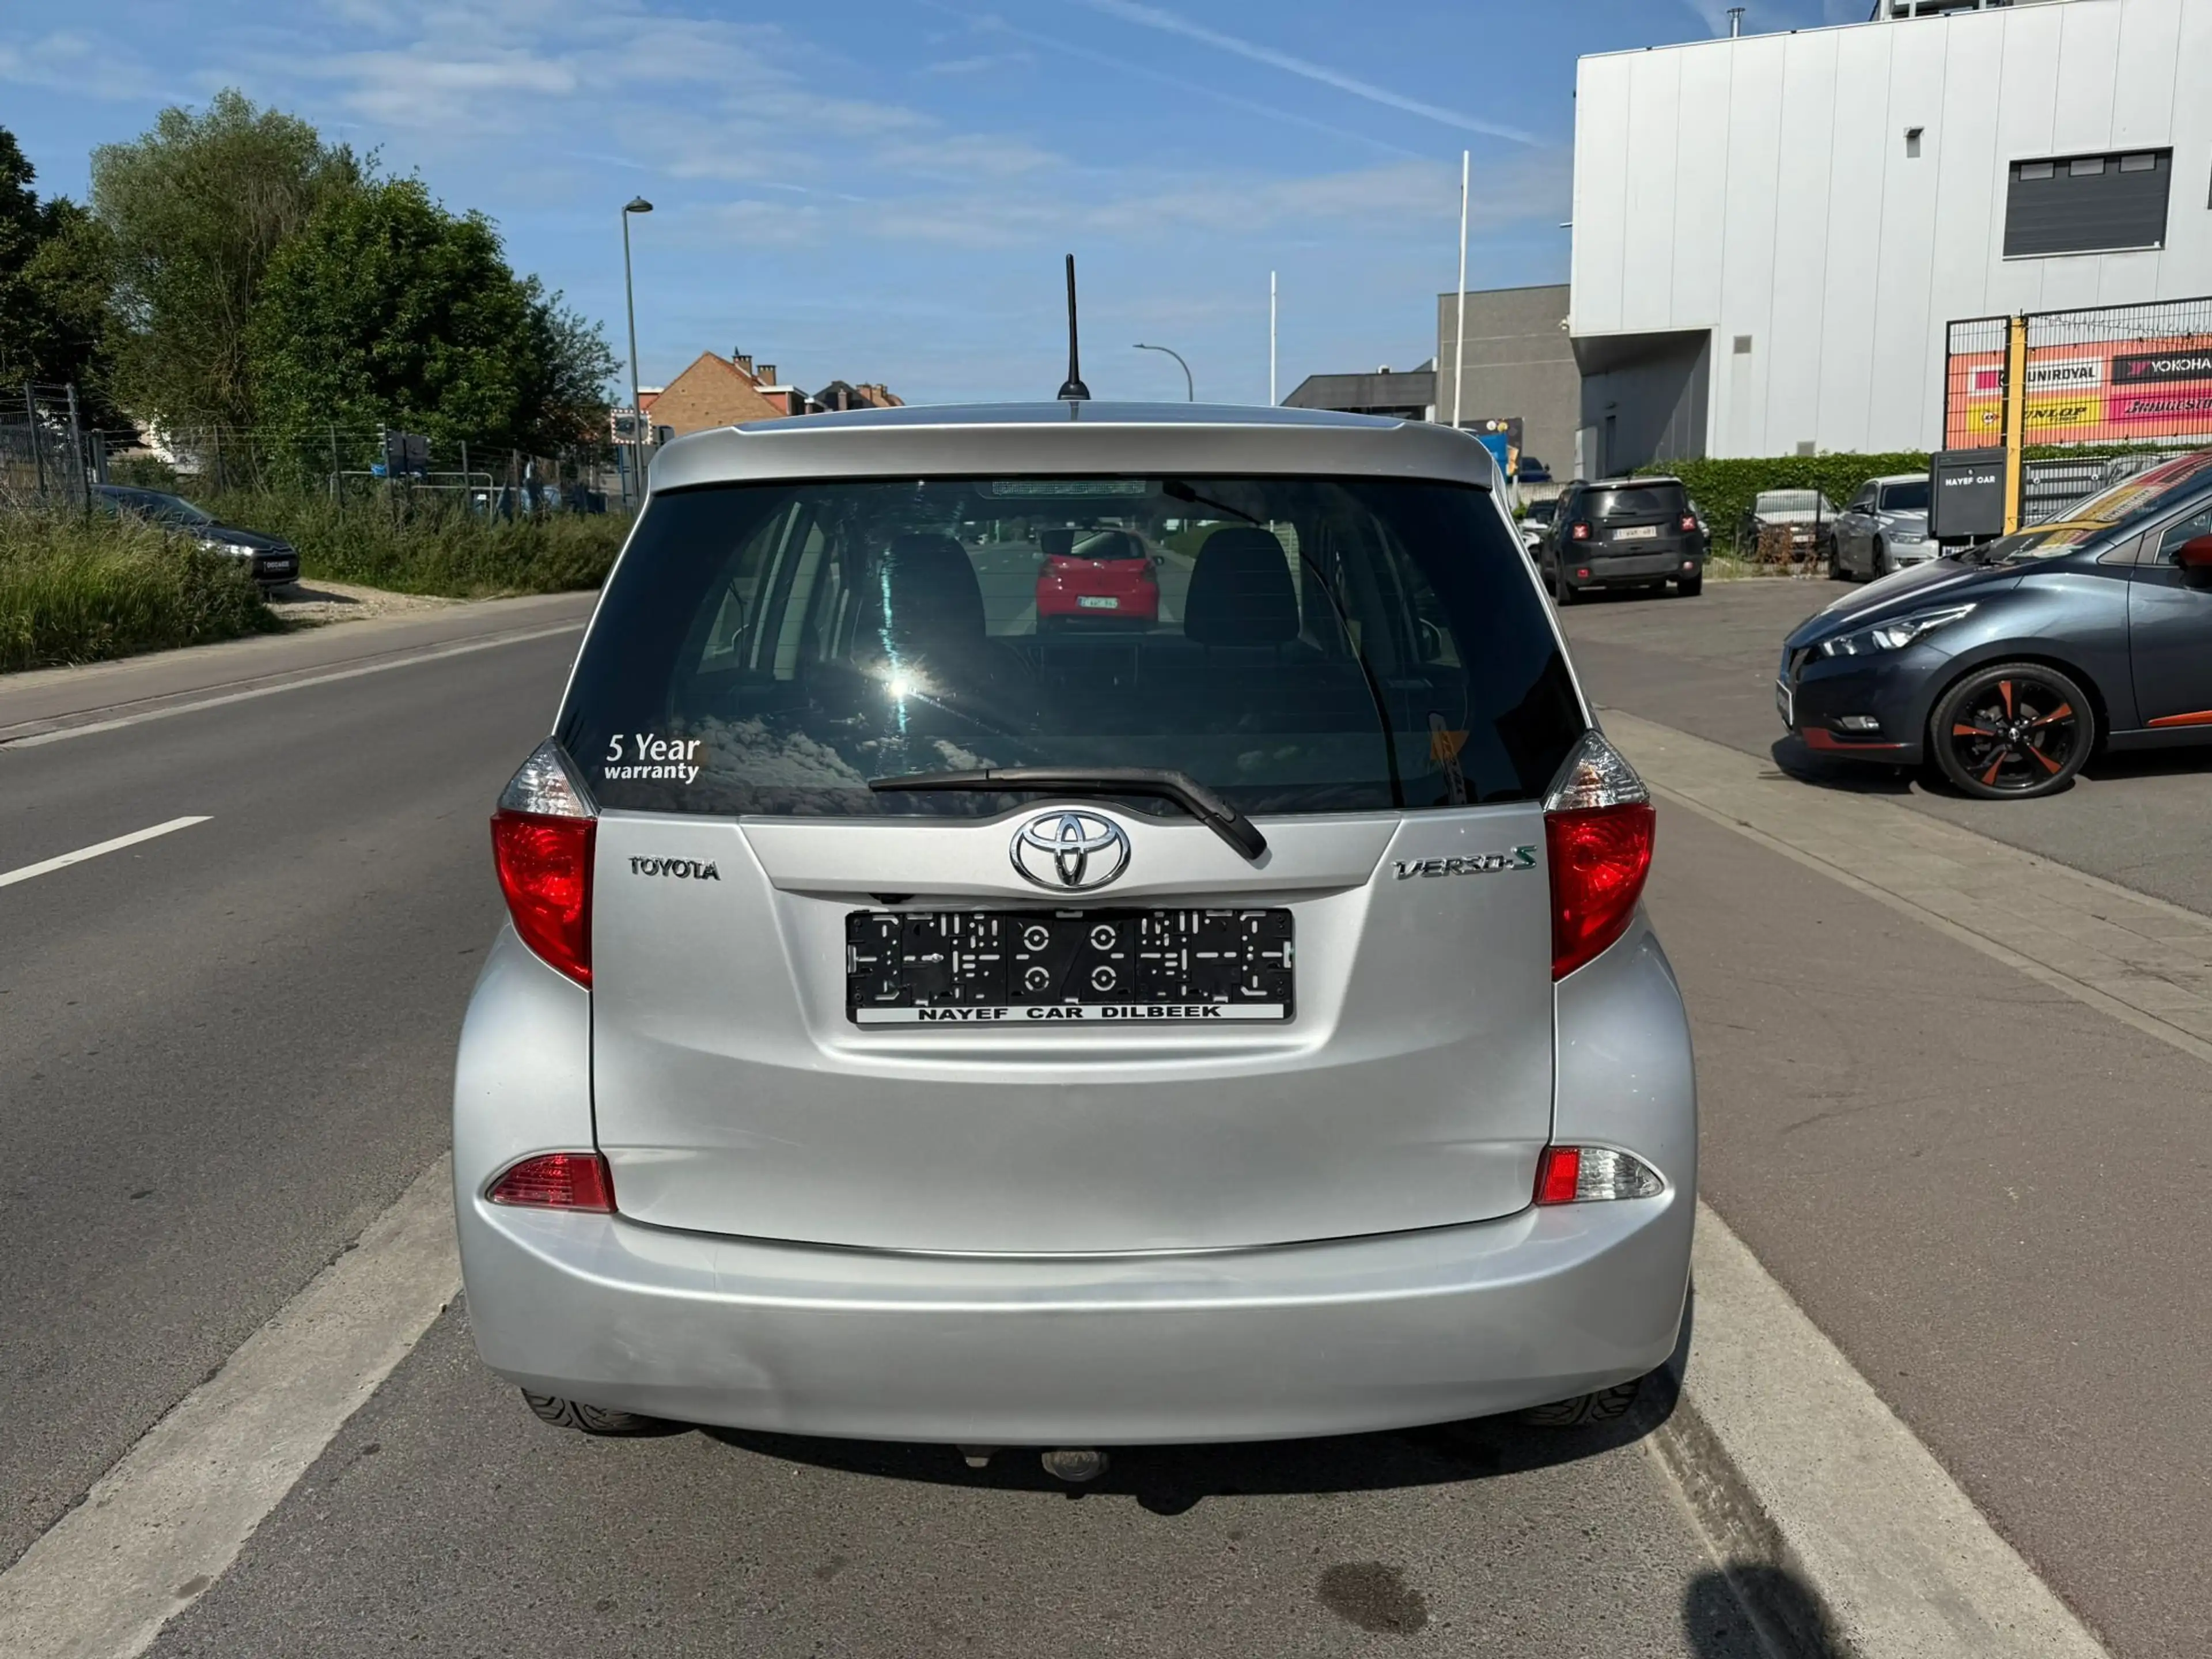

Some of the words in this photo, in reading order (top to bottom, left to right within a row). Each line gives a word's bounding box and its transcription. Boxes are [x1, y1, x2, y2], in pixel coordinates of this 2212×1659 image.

[2152, 358, 2212, 372] YOKOHA
[2028, 367, 2096, 382] UNIROYAL
[1945, 476, 1974, 486] NAYEF
[1976, 475, 1995, 484] CAR
[605, 734, 624, 762] 5
[635, 733, 700, 761] Year
[604, 763, 700, 785] warranty
[628, 855, 721, 881] TOYOTA
[918, 1008, 1009, 1020] NAYEF
[1026, 1007, 1084, 1018] CAR
[1101, 1005, 1222, 1018] DILBEEK
